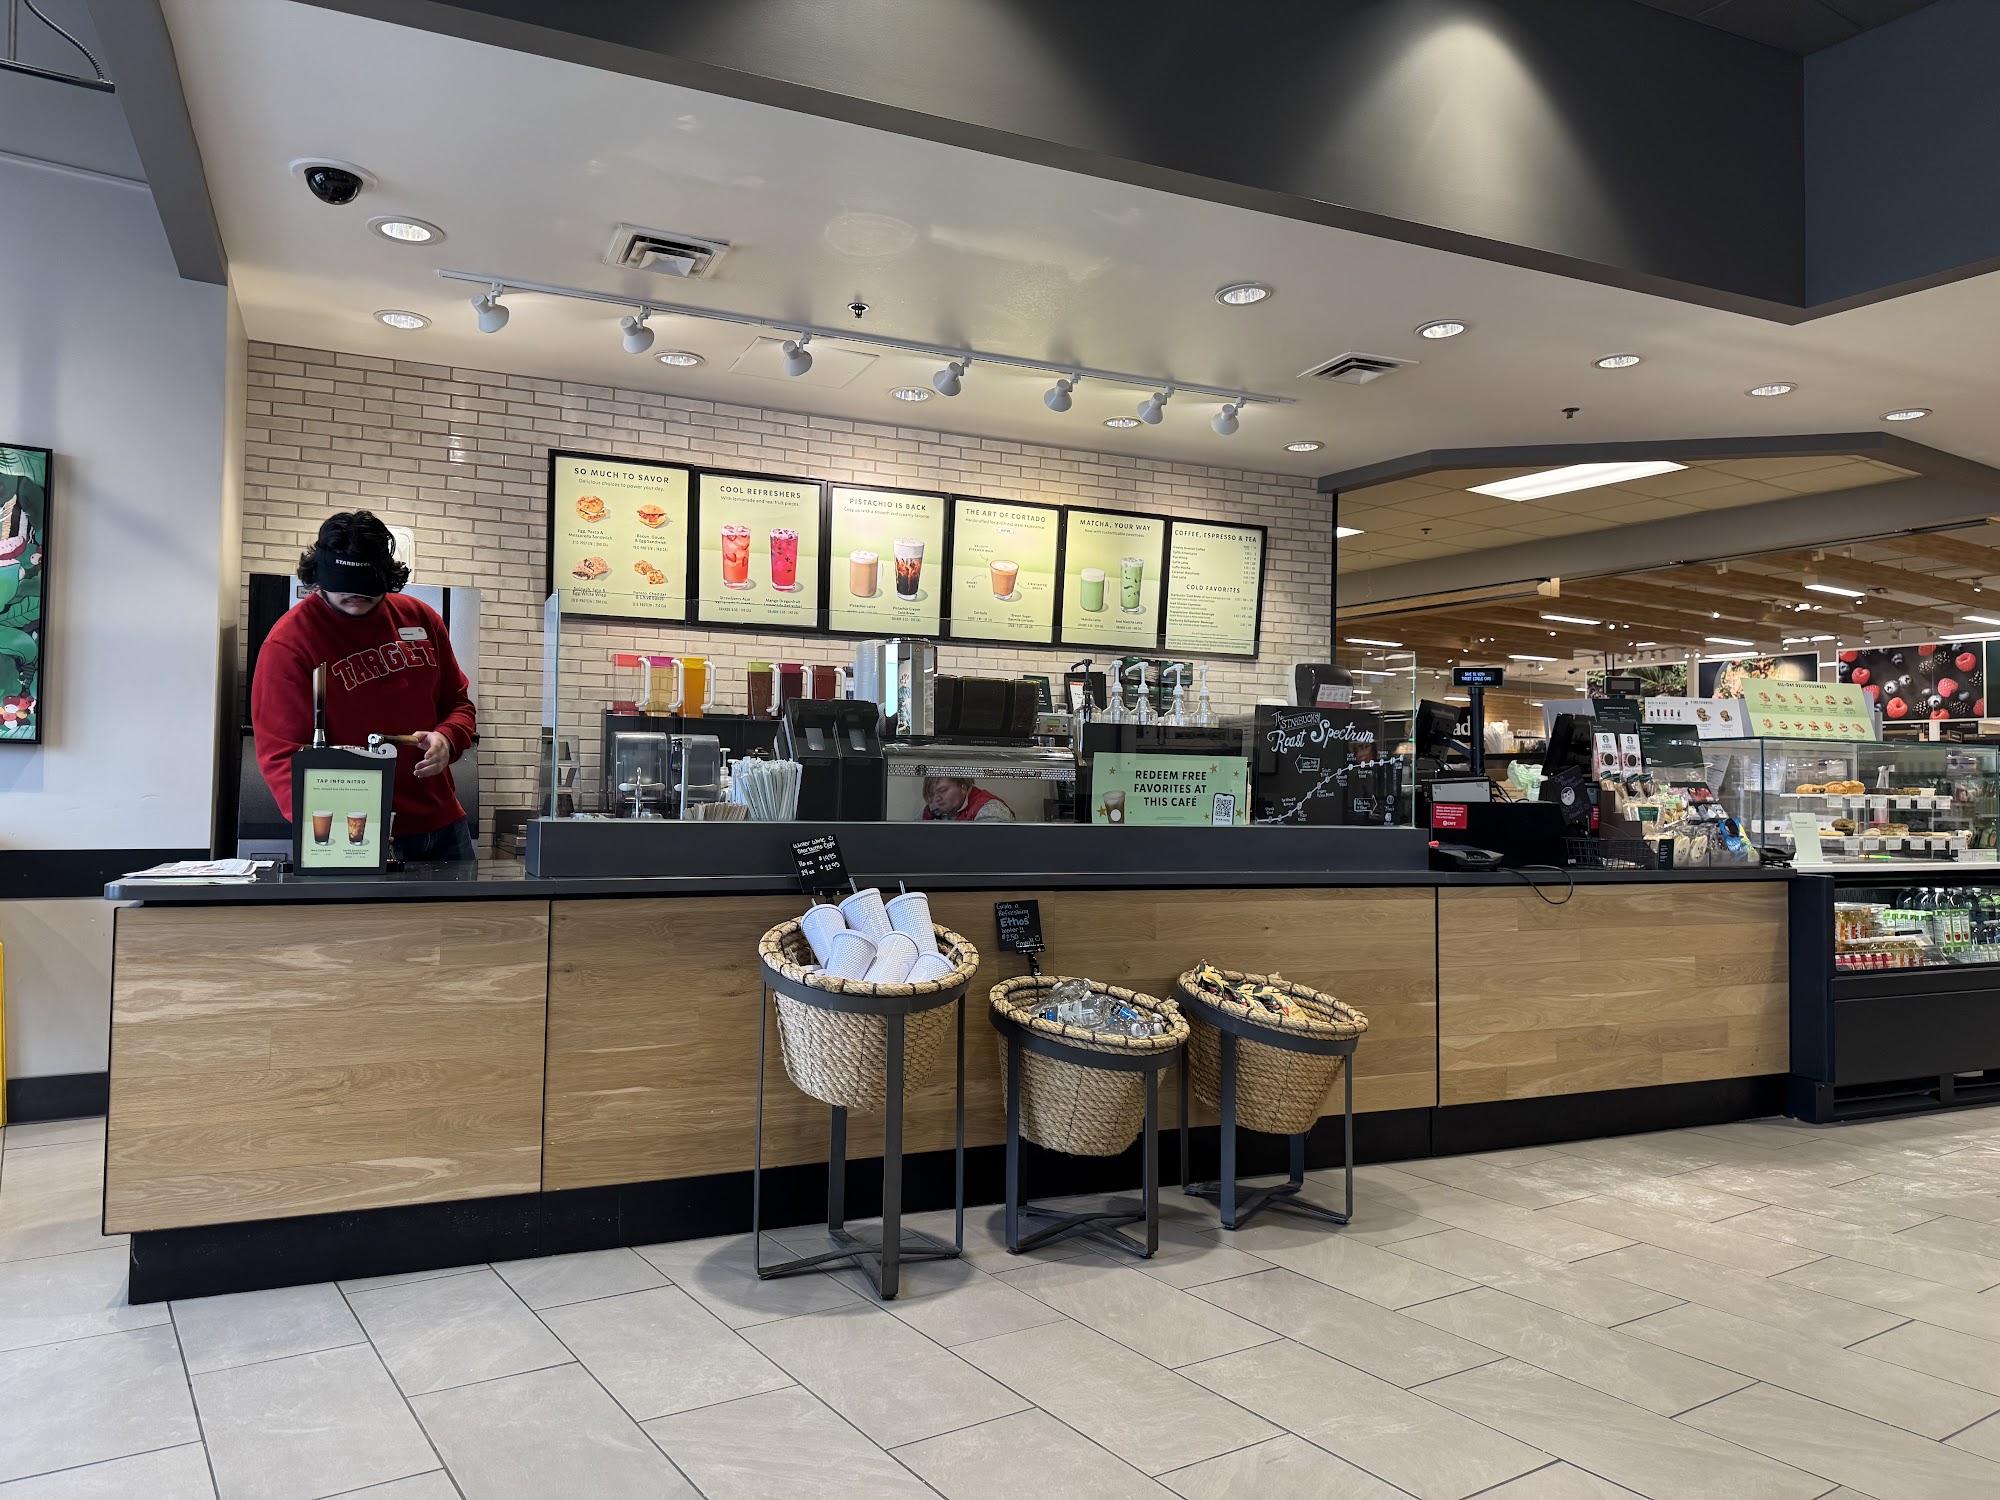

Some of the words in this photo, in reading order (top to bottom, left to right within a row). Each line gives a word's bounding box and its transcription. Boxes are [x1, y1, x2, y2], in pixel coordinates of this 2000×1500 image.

[590, 470, 619, 478] MUCH
[638, 474, 669, 484] SAVOR
[720, 486, 744, 494] COOL
[748, 488, 801, 498] REFRESHERS
[850, 498, 892, 508] PISTACHIO
[1011, 513, 1046, 522] CORTADO
[1080, 520, 1112, 528] MATCHA,
[1174, 530, 1201, 538] COFFEE,
[1204, 532, 1236, 541] ESPRESSO
[335, 559, 371, 567] STARBUCKS
[1205, 585, 1240, 594] FAVORITES
[332, 640, 437, 691] TARGET
[1267, 729, 1307, 753] Roast
[1311, 720, 1374, 748] Spectrum
[1135, 770, 1178, 780] REDEEM
[1182, 772, 1207, 780] FREE
[1134, 784, 1191, 793] FAVORITES
[1194, 785, 1207, 794] AT
[1144, 797, 1168, 806] THIS
[1171, 796, 1197, 807] CAFÉ
[1000, 917, 1029, 927] Ethos
